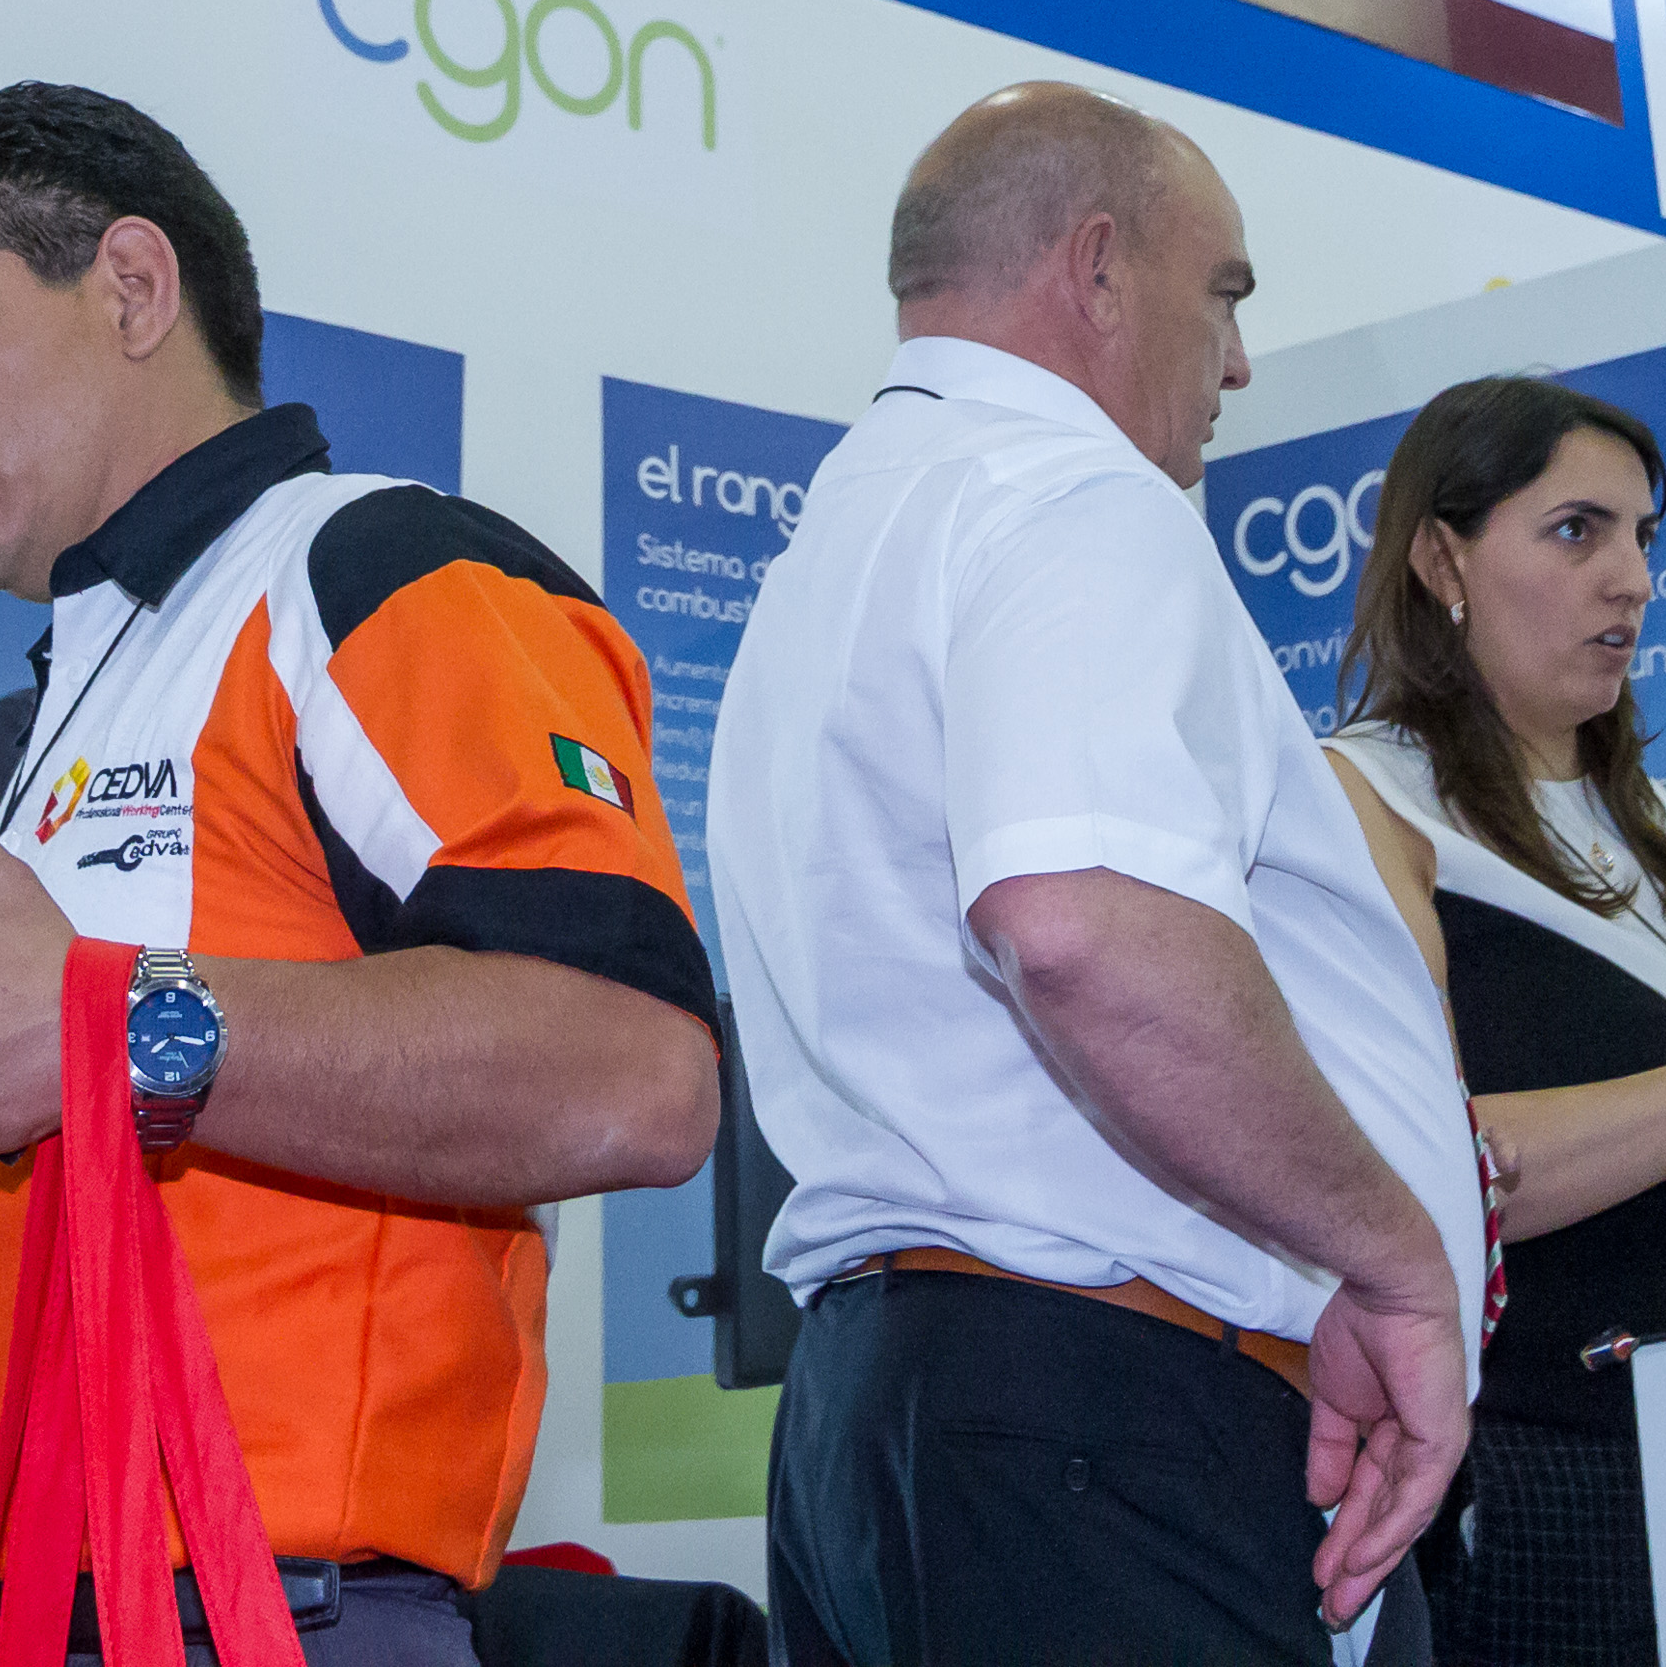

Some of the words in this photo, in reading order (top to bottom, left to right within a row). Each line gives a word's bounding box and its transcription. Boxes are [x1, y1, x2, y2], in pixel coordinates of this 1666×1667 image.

[637, 444, 683, 504] el
[637, 532, 746, 581] Sistema
[87, 758, 178, 803] CEDVA
